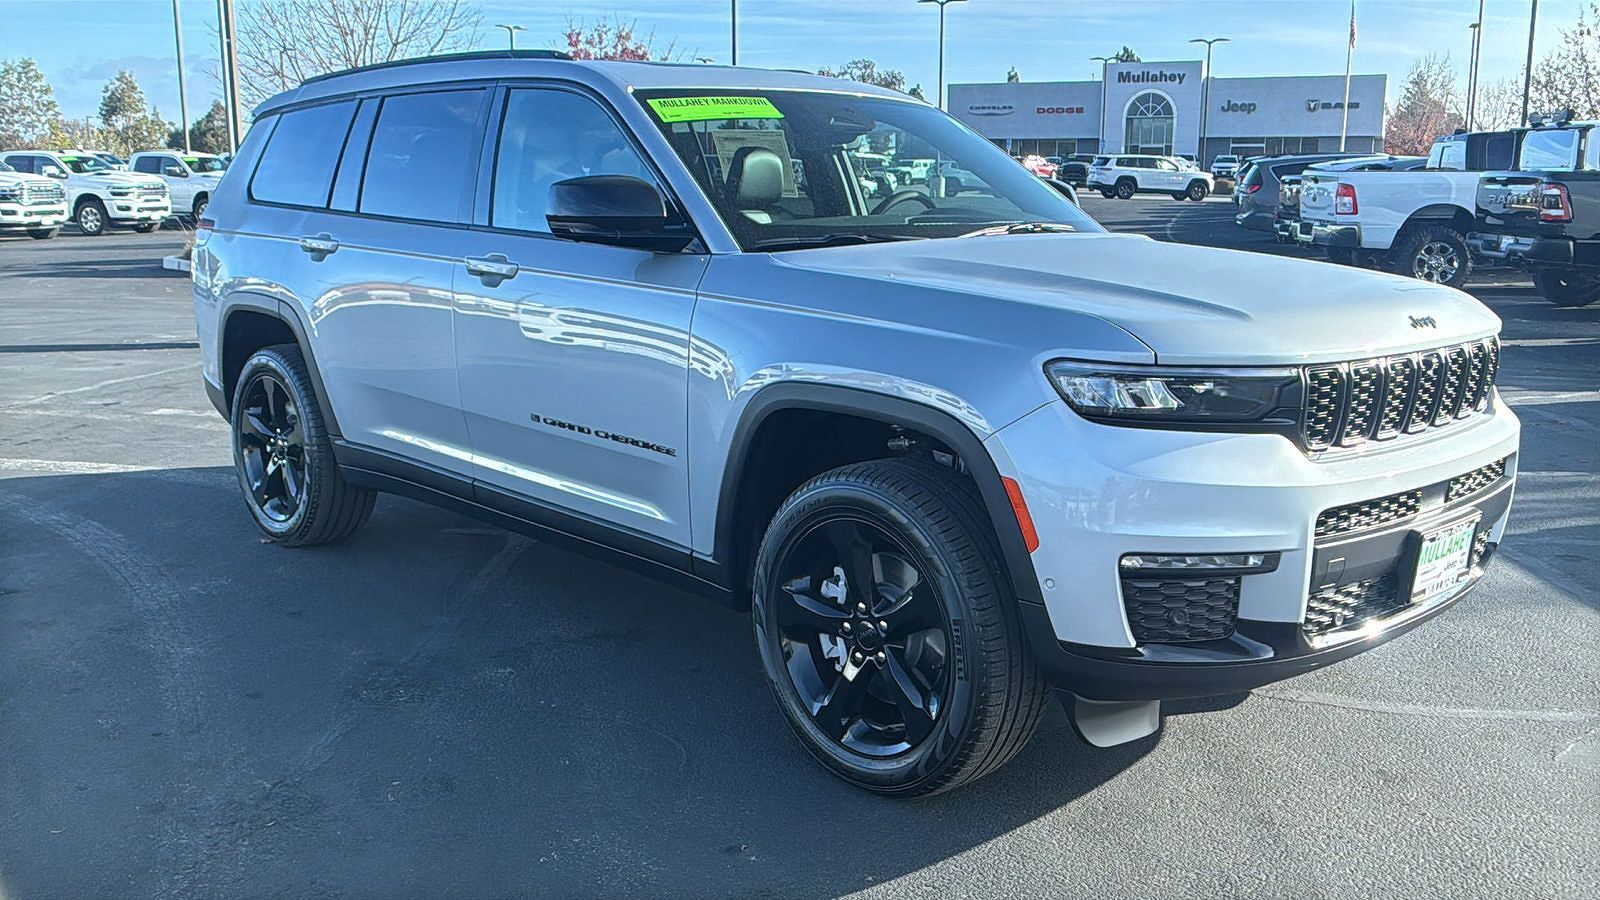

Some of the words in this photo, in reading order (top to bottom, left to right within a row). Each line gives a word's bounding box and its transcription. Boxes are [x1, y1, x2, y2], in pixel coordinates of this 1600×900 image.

[1117, 71, 1186, 85] Mullahey
[658, 99, 710, 108] MULLAHEY
[712, 97, 768, 106] MARKDOWN
[1221, 100, 1257, 114] Jeep
[543, 417, 592, 435] GRAND
[594, 430, 677, 457] CHEROKEE
[1420, 531, 1471, 565] MULLAHEY
